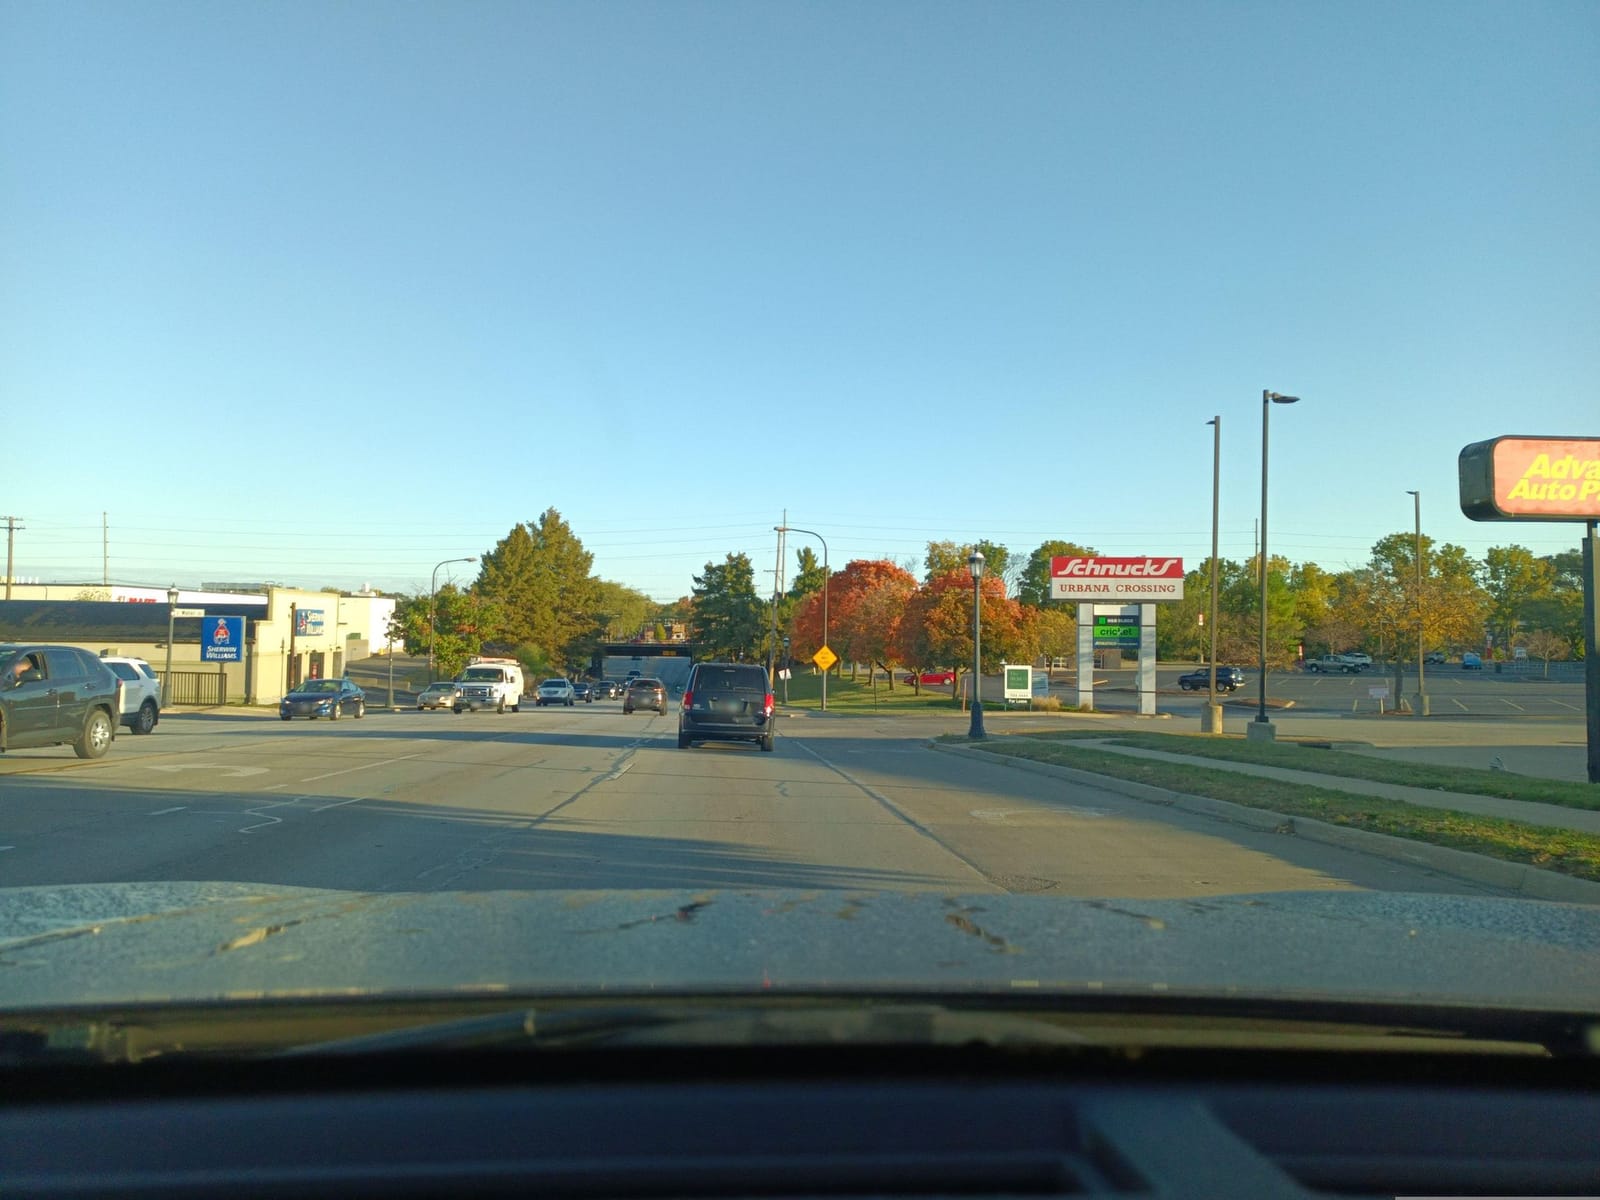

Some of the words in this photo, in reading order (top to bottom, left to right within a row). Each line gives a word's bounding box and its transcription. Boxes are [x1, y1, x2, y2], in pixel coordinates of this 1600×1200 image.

[1506, 478, 1577, 501] Auto
[1060, 584, 1110, 593] URBANA
[1115, 584, 1176, 593] CROSSING
[207, 645, 237, 653] SHERWIN
